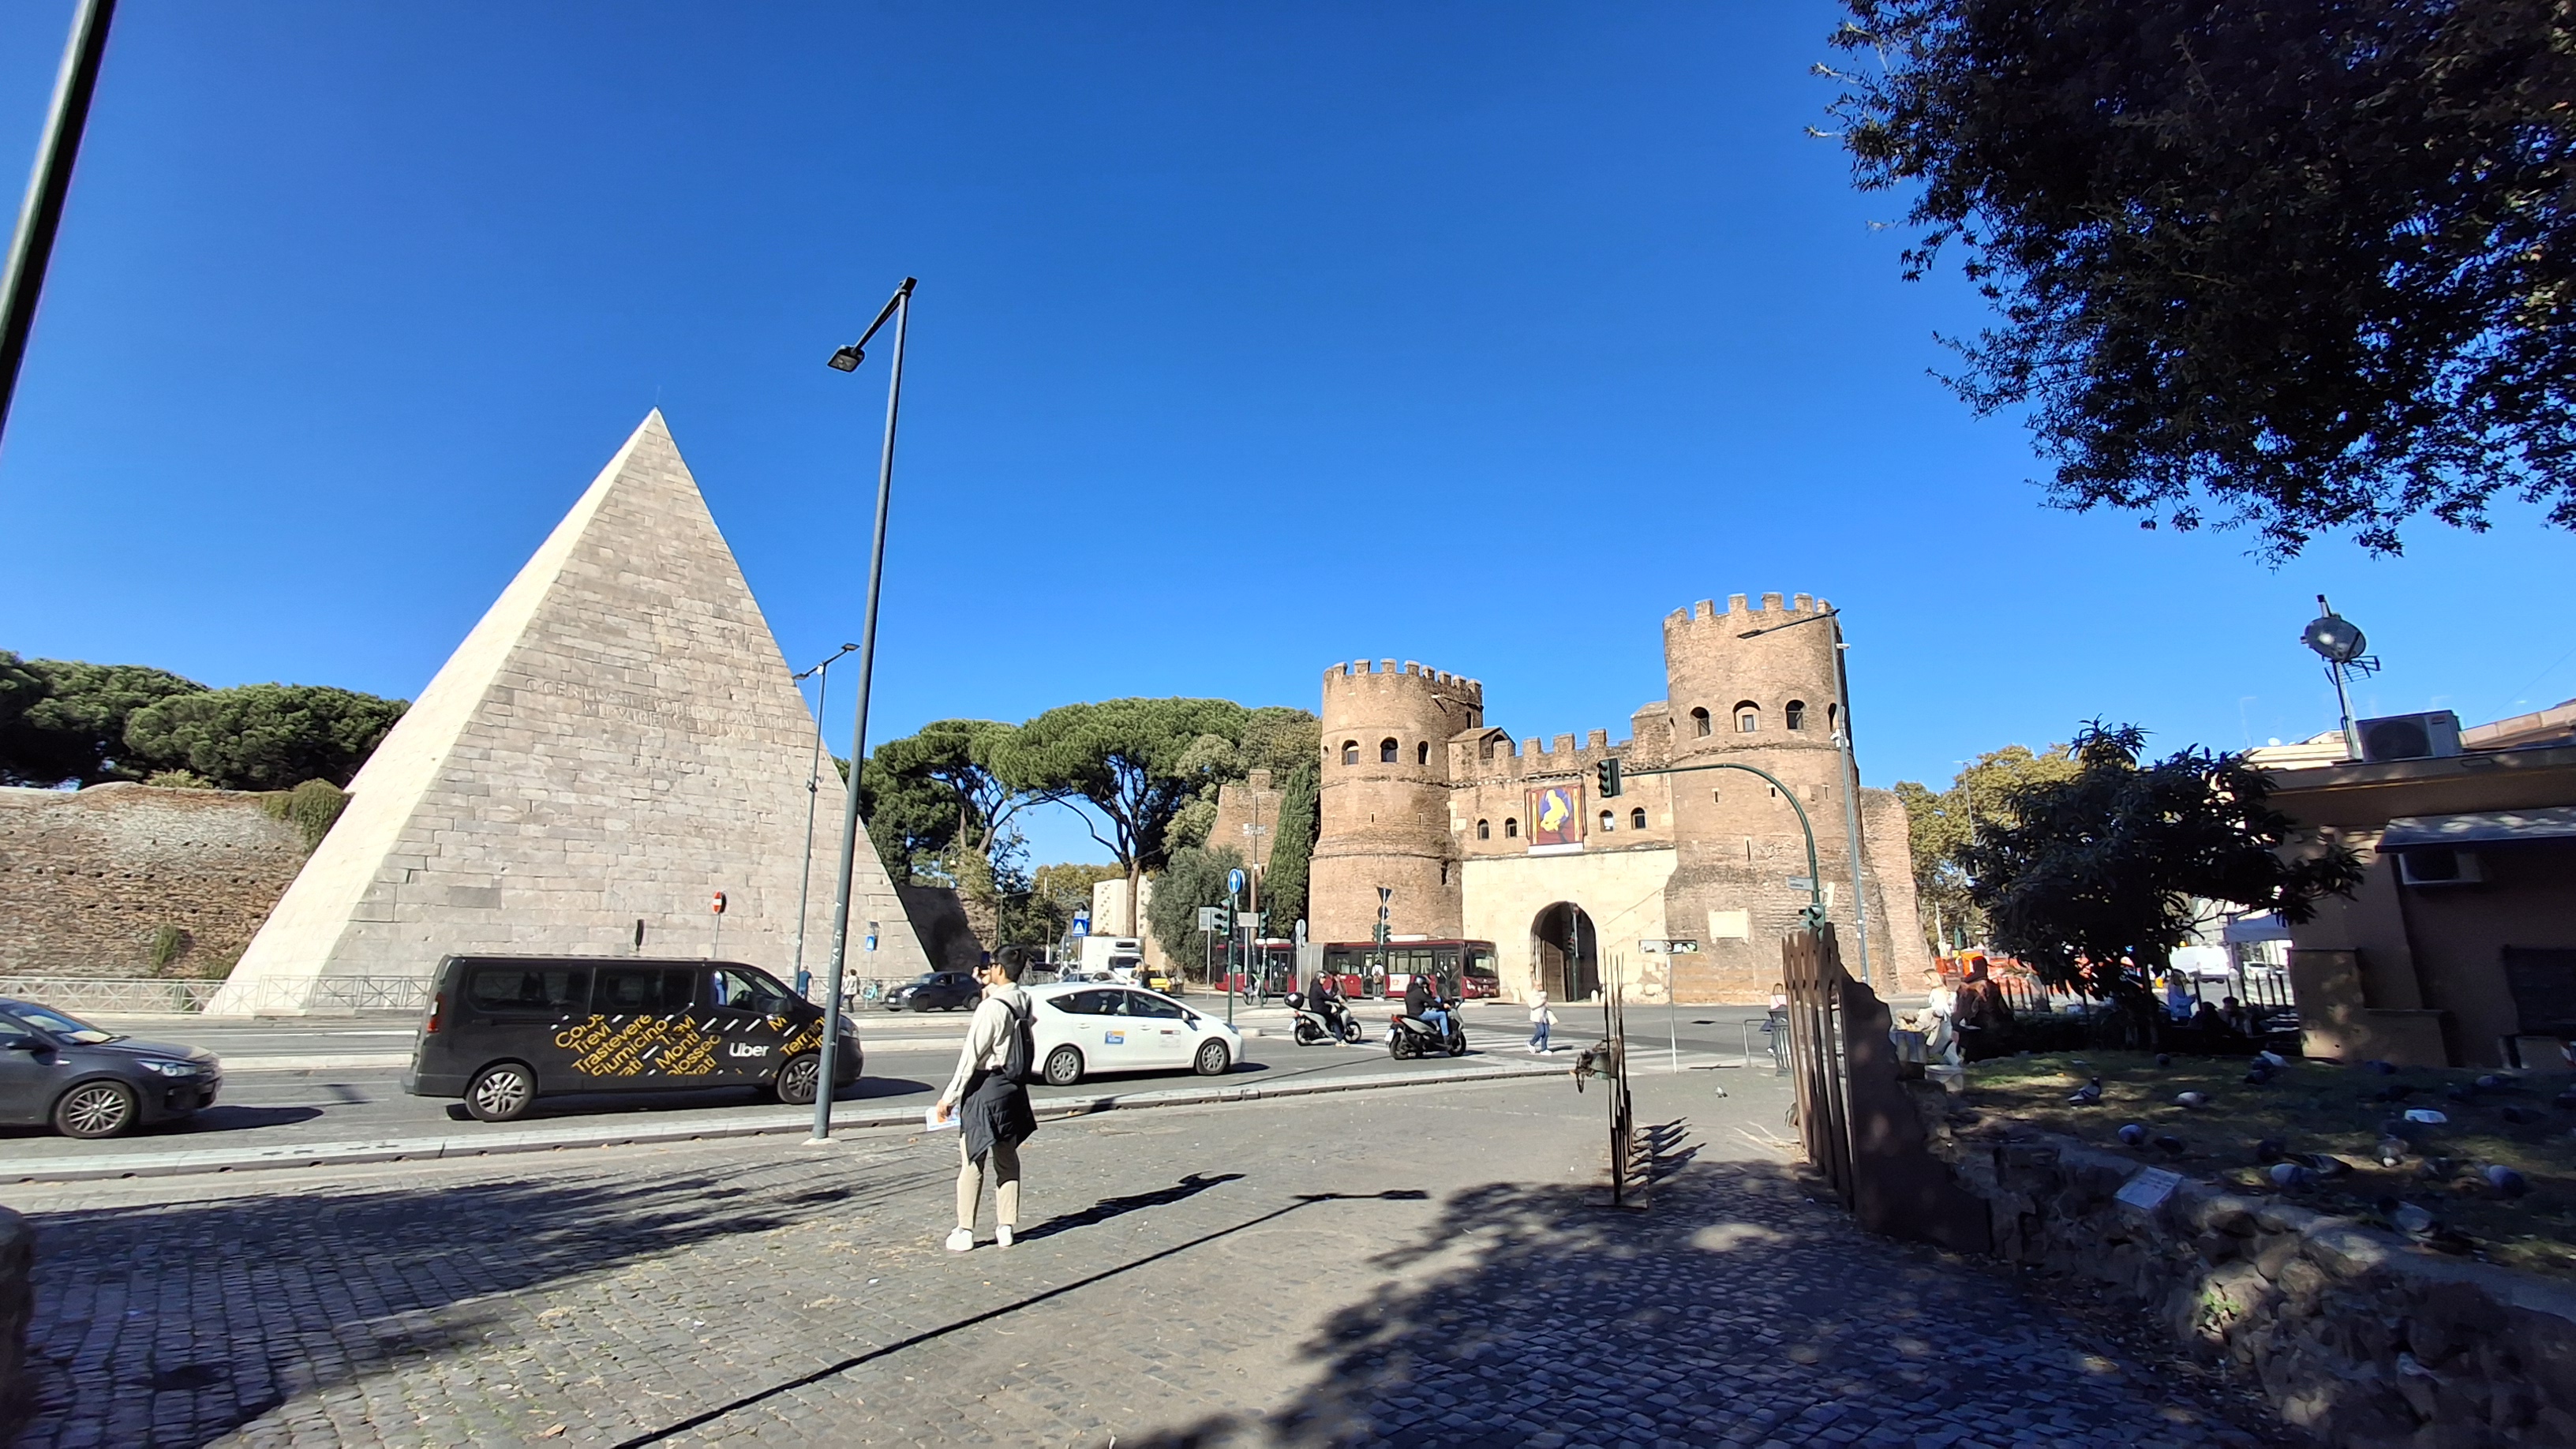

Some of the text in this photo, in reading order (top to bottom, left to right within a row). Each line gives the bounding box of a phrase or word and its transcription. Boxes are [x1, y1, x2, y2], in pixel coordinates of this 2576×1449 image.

[569, 1022, 612, 1054] Trevi
[571, 1014, 653, 1073] Trastevere
[654, 1029, 702, 1069] Monti
[728, 1042, 770, 1058] Uber
